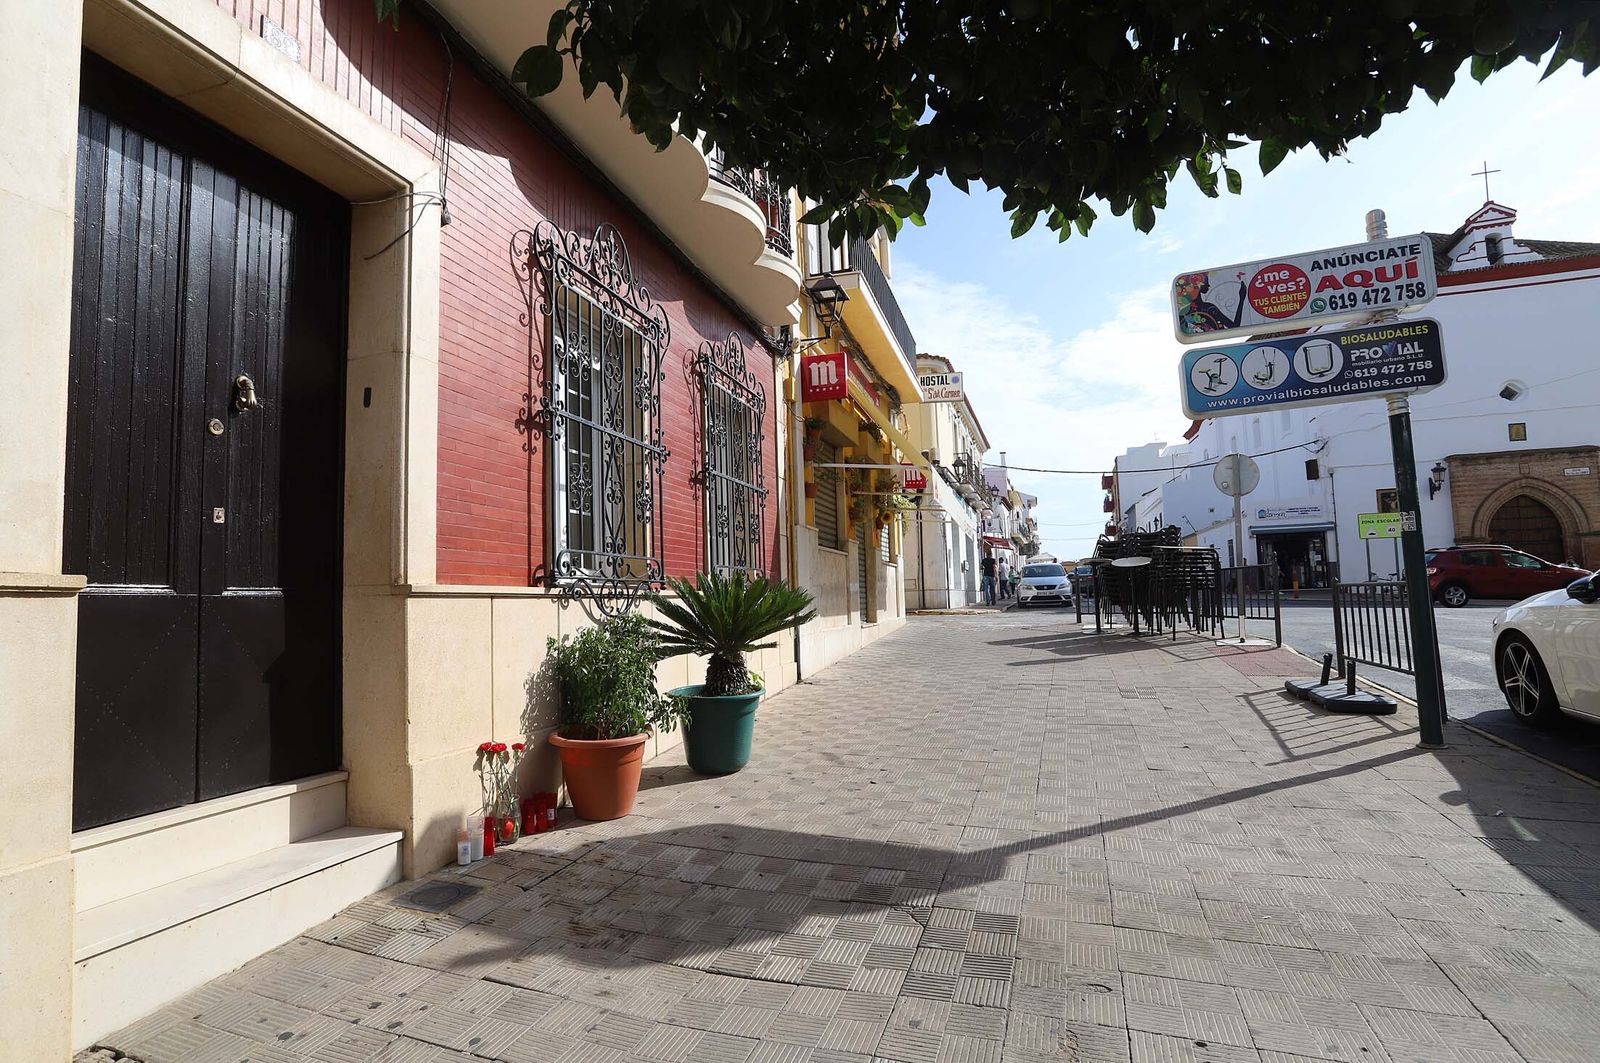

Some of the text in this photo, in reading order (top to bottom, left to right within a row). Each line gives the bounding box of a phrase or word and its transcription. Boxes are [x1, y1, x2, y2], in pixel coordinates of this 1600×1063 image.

[1310, 243, 1421, 272] ANÚNCIATE
[1255, 269, 1290, 288] ¿me
[1315, 256, 1419, 293] AQUÍ
[1267, 277, 1305, 294] ves?
[1253, 291, 1308, 306] TUS CLIENTES
[1329, 281, 1426, 311] 619 472 758
[1340, 324, 1429, 346] BIOSALUDABLES
[1351, 359, 1382, 367] mobiliario
[1354, 360, 1433, 378] 619 472 758
[920, 375, 950, 387] HOSTAL
[941, 387, 961, 399] Carmen
[1207, 374, 1427, 408] www.provialbiosaludables.com
